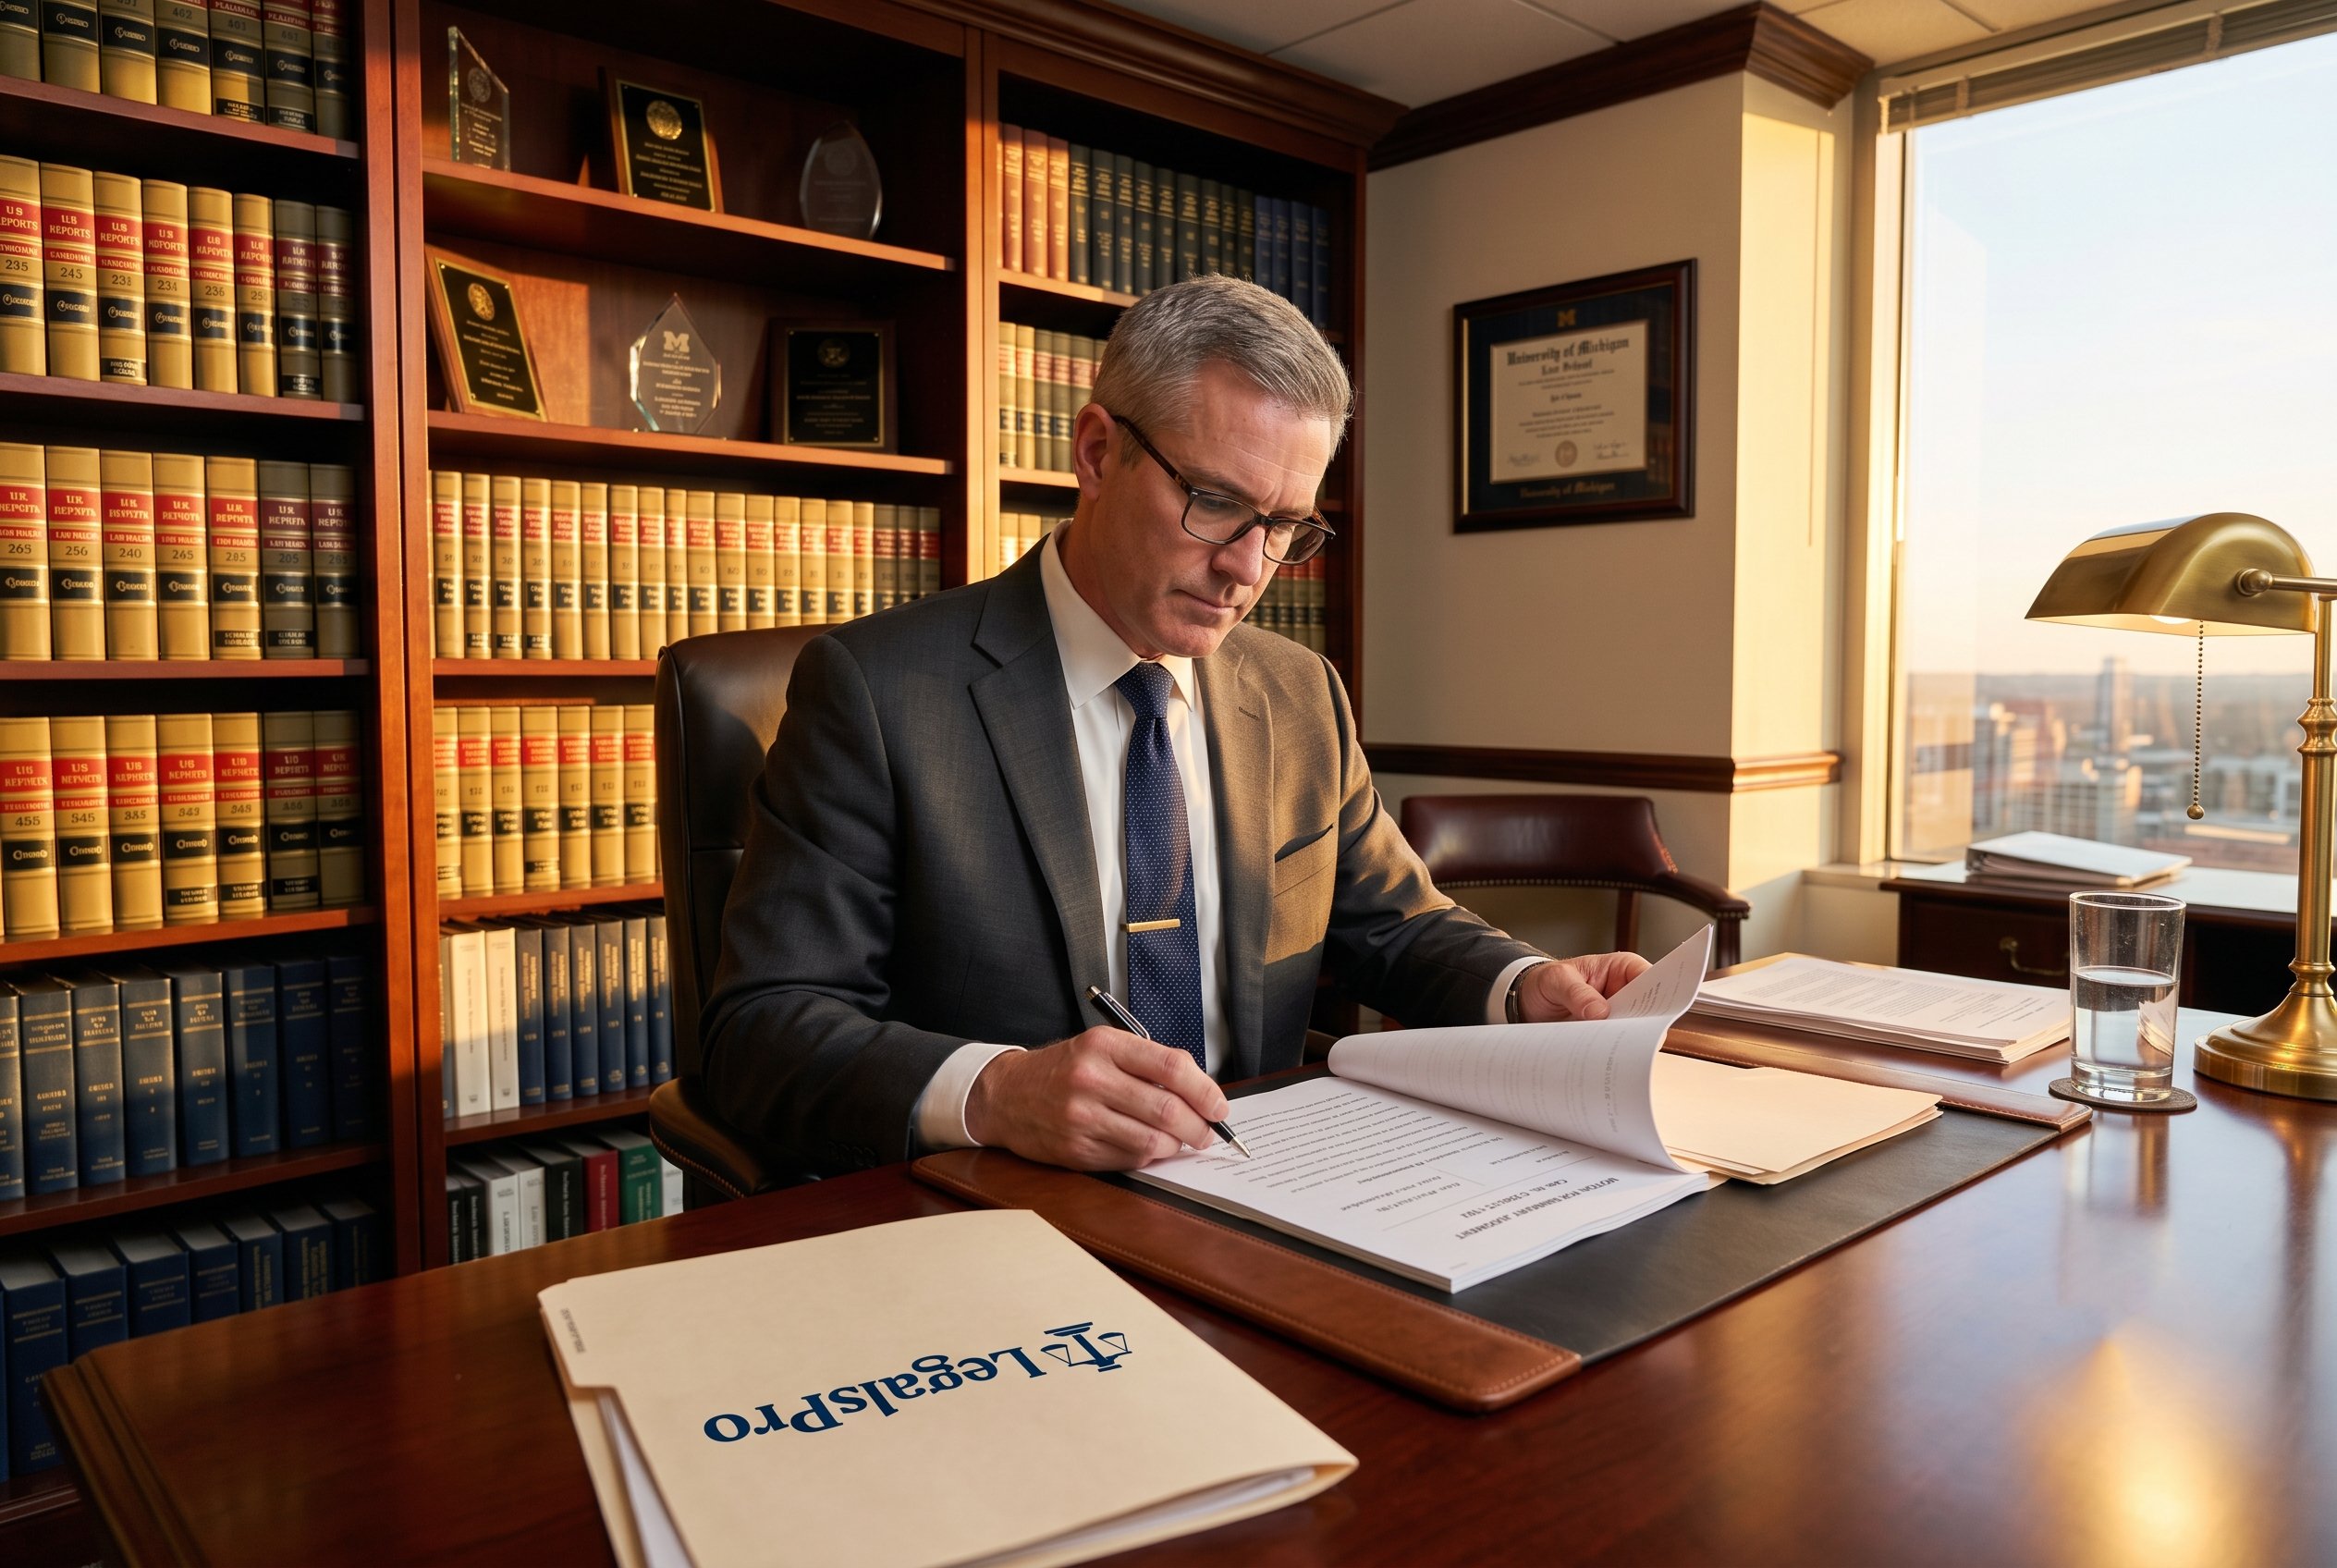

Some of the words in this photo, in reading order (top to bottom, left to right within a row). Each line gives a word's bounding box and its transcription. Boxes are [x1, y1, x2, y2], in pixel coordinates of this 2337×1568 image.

[6, 259, 29, 272] 235
[60, 266, 83, 279] 245
[205, 285, 226, 298] 236
[1557, 310, 1577, 327] M
[663, 331, 690, 353] M
[1563, 342, 1575, 358] of
[65, 545, 89, 557] 256
[118, 547, 142, 558] 240
[172, 549, 195, 560] 265
[15, 816, 41, 827] 455
[704, 1346, 1046, 1442] LegalsPro
